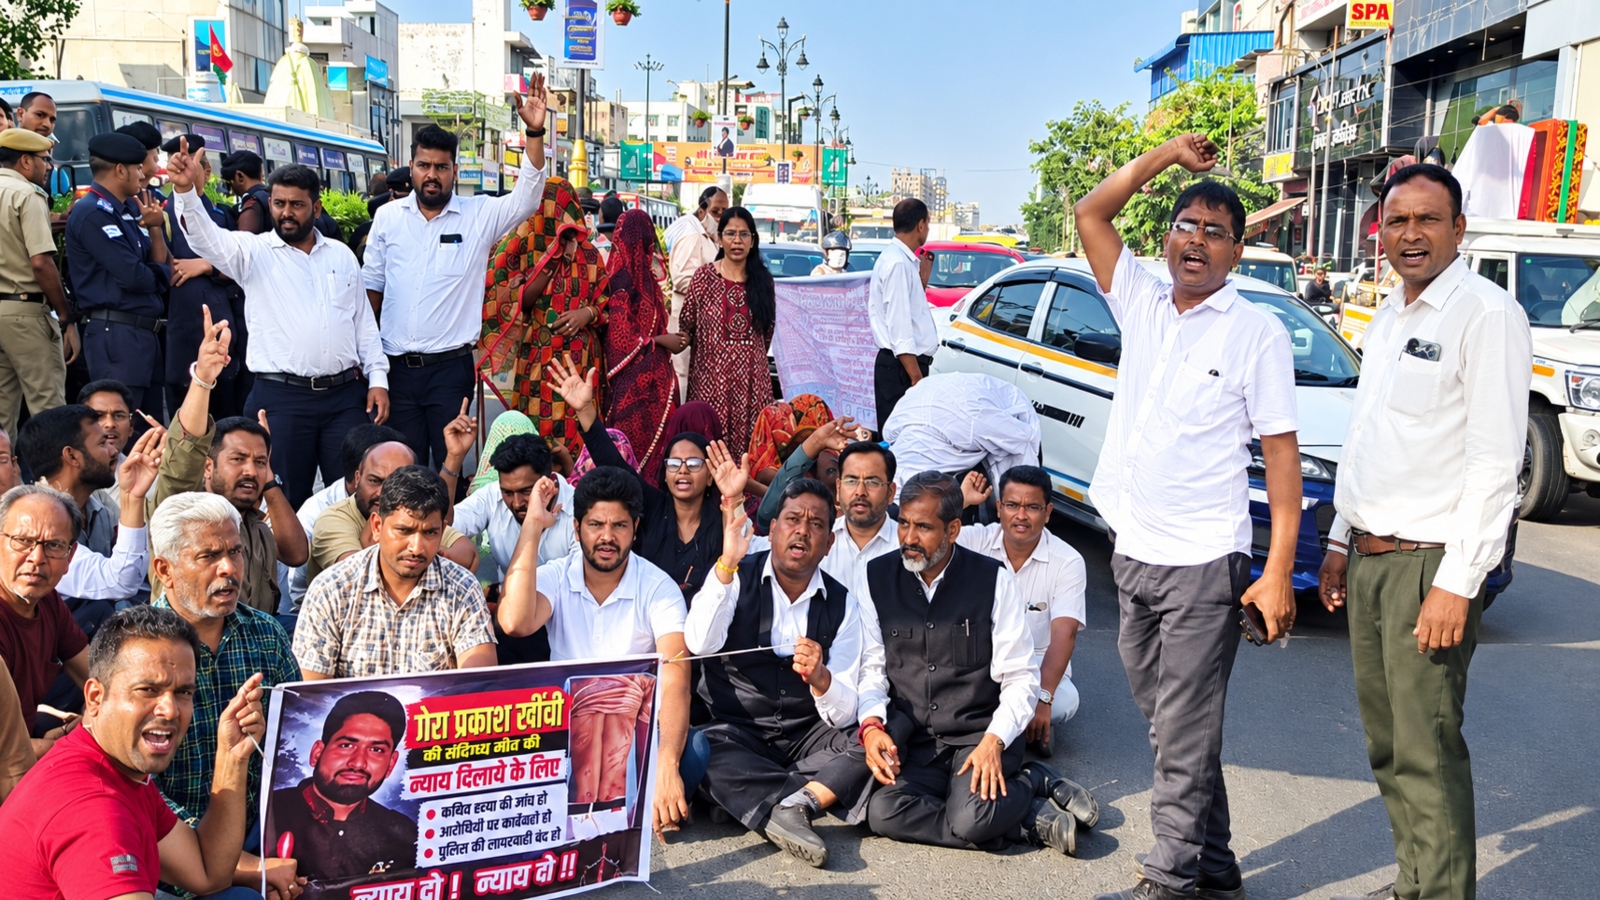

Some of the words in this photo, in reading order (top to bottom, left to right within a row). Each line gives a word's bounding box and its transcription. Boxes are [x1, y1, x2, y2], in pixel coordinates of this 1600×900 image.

[1352, 3, 1389, 20] SPA
[454, 704, 512, 739] प्रकाश
[423, 745, 442, 762] की
[523, 733, 541, 750] की
[409, 770, 452, 794] न्याय
[456, 759, 507, 789] दिलाये
[510, 757, 527, 781] के
[530, 754, 561, 780] लिए
[499, 794, 513, 810] की
[537, 789, 548, 806] हो
[487, 816, 499, 831] पर
[542, 808, 553, 824] हो
[438, 840, 469, 863] पुलिस
[471, 836, 486, 853] की
[551, 826, 562, 841] हो
[476, 864, 531, 893] न्याय
[535, 856, 557, 882] दो
